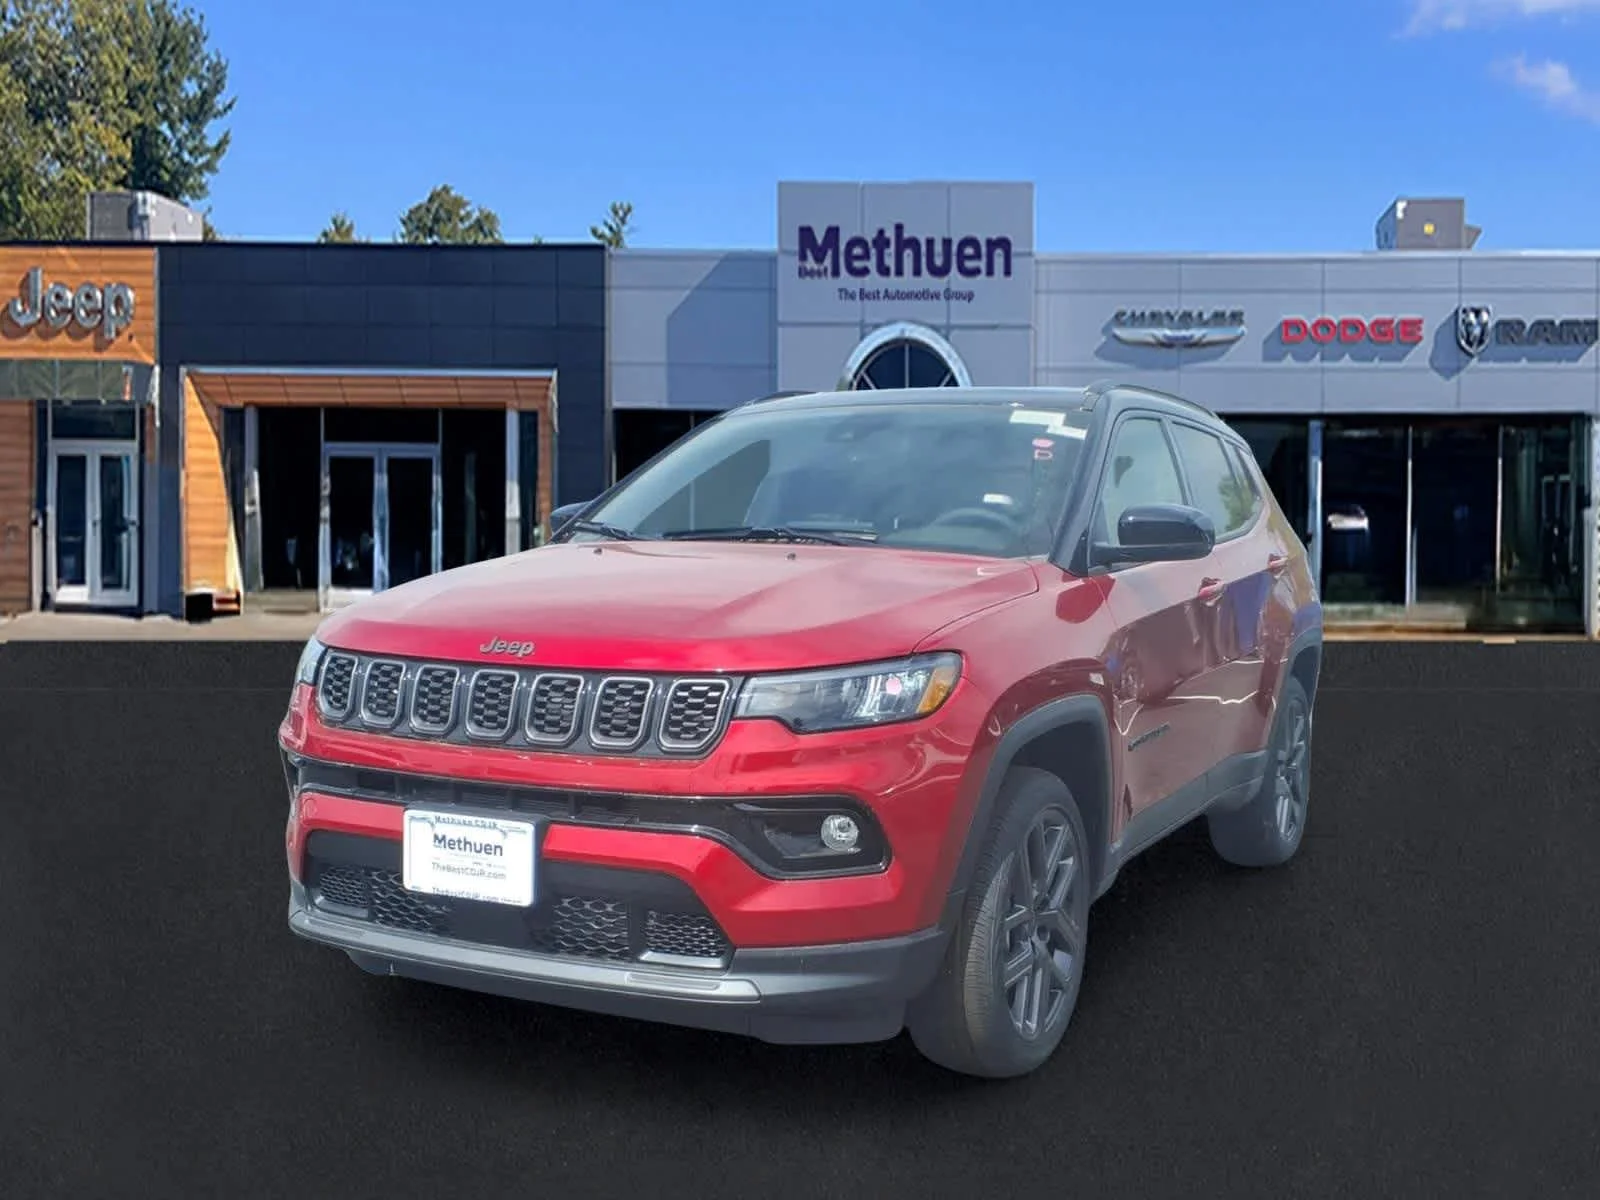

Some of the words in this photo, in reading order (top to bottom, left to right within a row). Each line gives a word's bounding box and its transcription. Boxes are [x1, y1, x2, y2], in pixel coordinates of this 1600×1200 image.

[798, 222, 1012, 278] Methuen
[8, 267, 135, 340] Jeep
[838, 287, 856, 301] The
[859, 287, 880, 301] Best
[883, 287, 941, 301] Automotive
[943, 287, 975, 303] Group
[1113, 308, 1245, 325] CHRYSLER
[1281, 317, 1424, 344] DODGE
[1495, 318, 1598, 346] RAM
[480, 636, 535, 658] Jeep
[433, 833, 504, 857] Methuen
